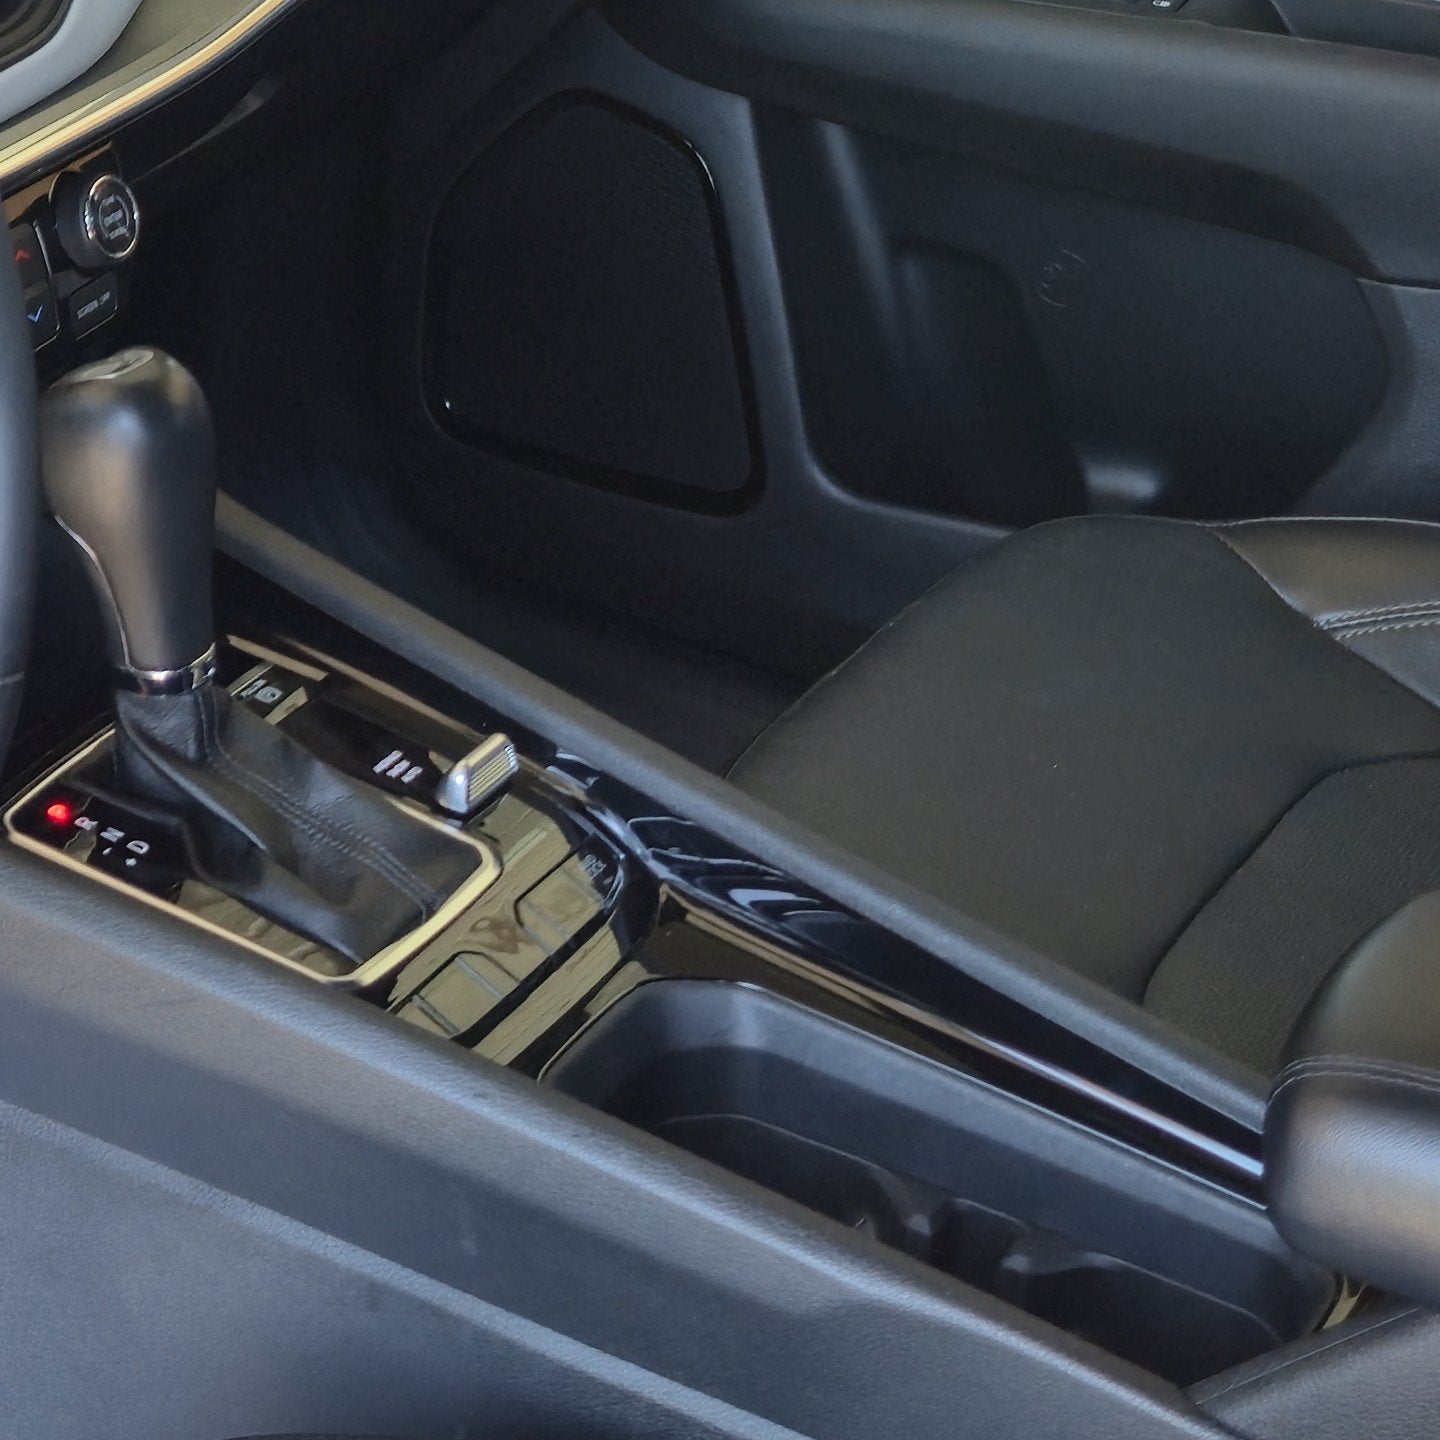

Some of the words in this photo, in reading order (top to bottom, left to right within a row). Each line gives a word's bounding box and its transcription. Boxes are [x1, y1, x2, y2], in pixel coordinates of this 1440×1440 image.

[73, 816, 99, 831] R
[100, 827, 125, 843] N
[126, 840, 150, 855] D
